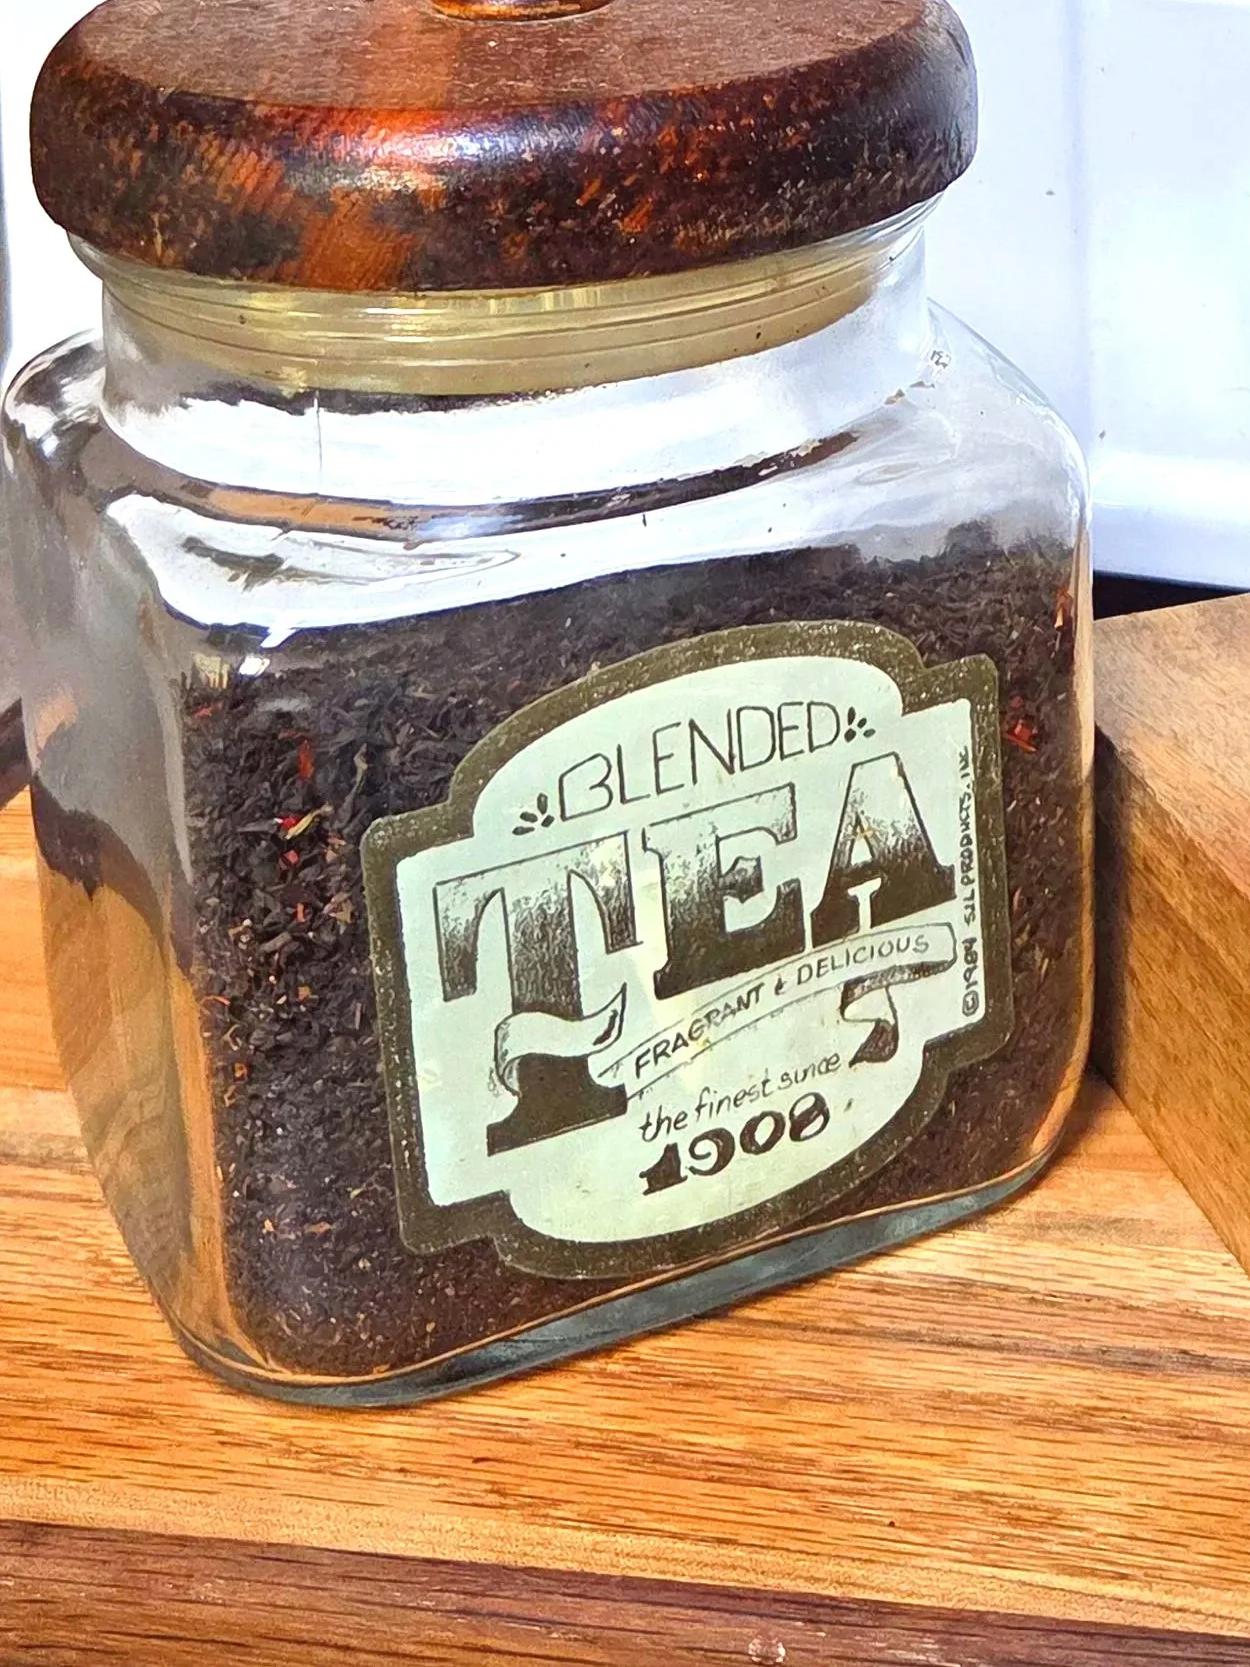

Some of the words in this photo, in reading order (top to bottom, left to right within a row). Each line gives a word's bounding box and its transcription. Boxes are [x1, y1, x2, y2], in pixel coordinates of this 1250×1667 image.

[559, 700, 841, 822] BLENDED
[432, 751, 957, 1156] TEA
[634, 982, 766, 1079] FRAGRANT
[796, 934, 931, 986] DELICIOUS
[639, 1105, 688, 1143] the
[695, 1068, 772, 1122] finest
[777, 1053, 842, 1091] since
[639, 1092, 831, 1196] 1908
